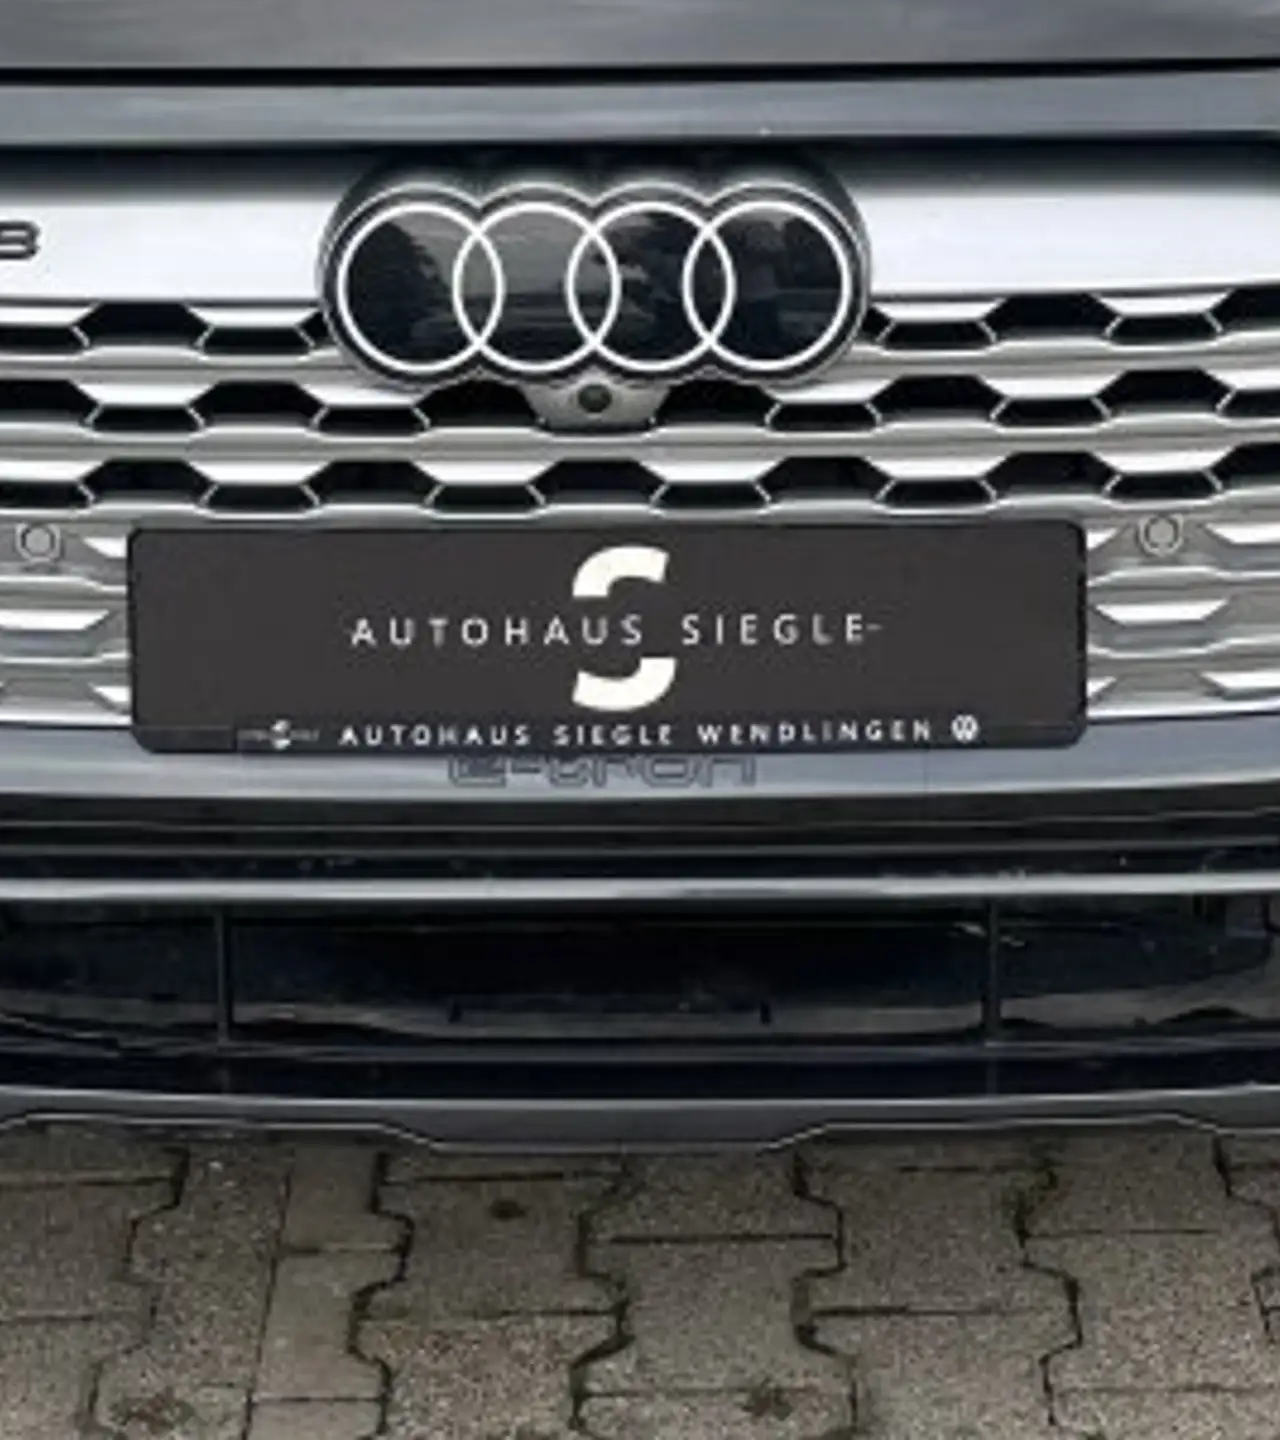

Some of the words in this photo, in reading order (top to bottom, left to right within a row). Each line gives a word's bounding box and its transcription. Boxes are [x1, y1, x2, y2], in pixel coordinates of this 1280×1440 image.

[350, 615, 643, 648] AUTOHAUS
[681, 613, 865, 646] SIEGLE
[338, 723, 531, 747] AUTOHAUS
[551, 724, 673, 747] SIEGLE
[696, 718, 931, 746] WENDLINGEN
